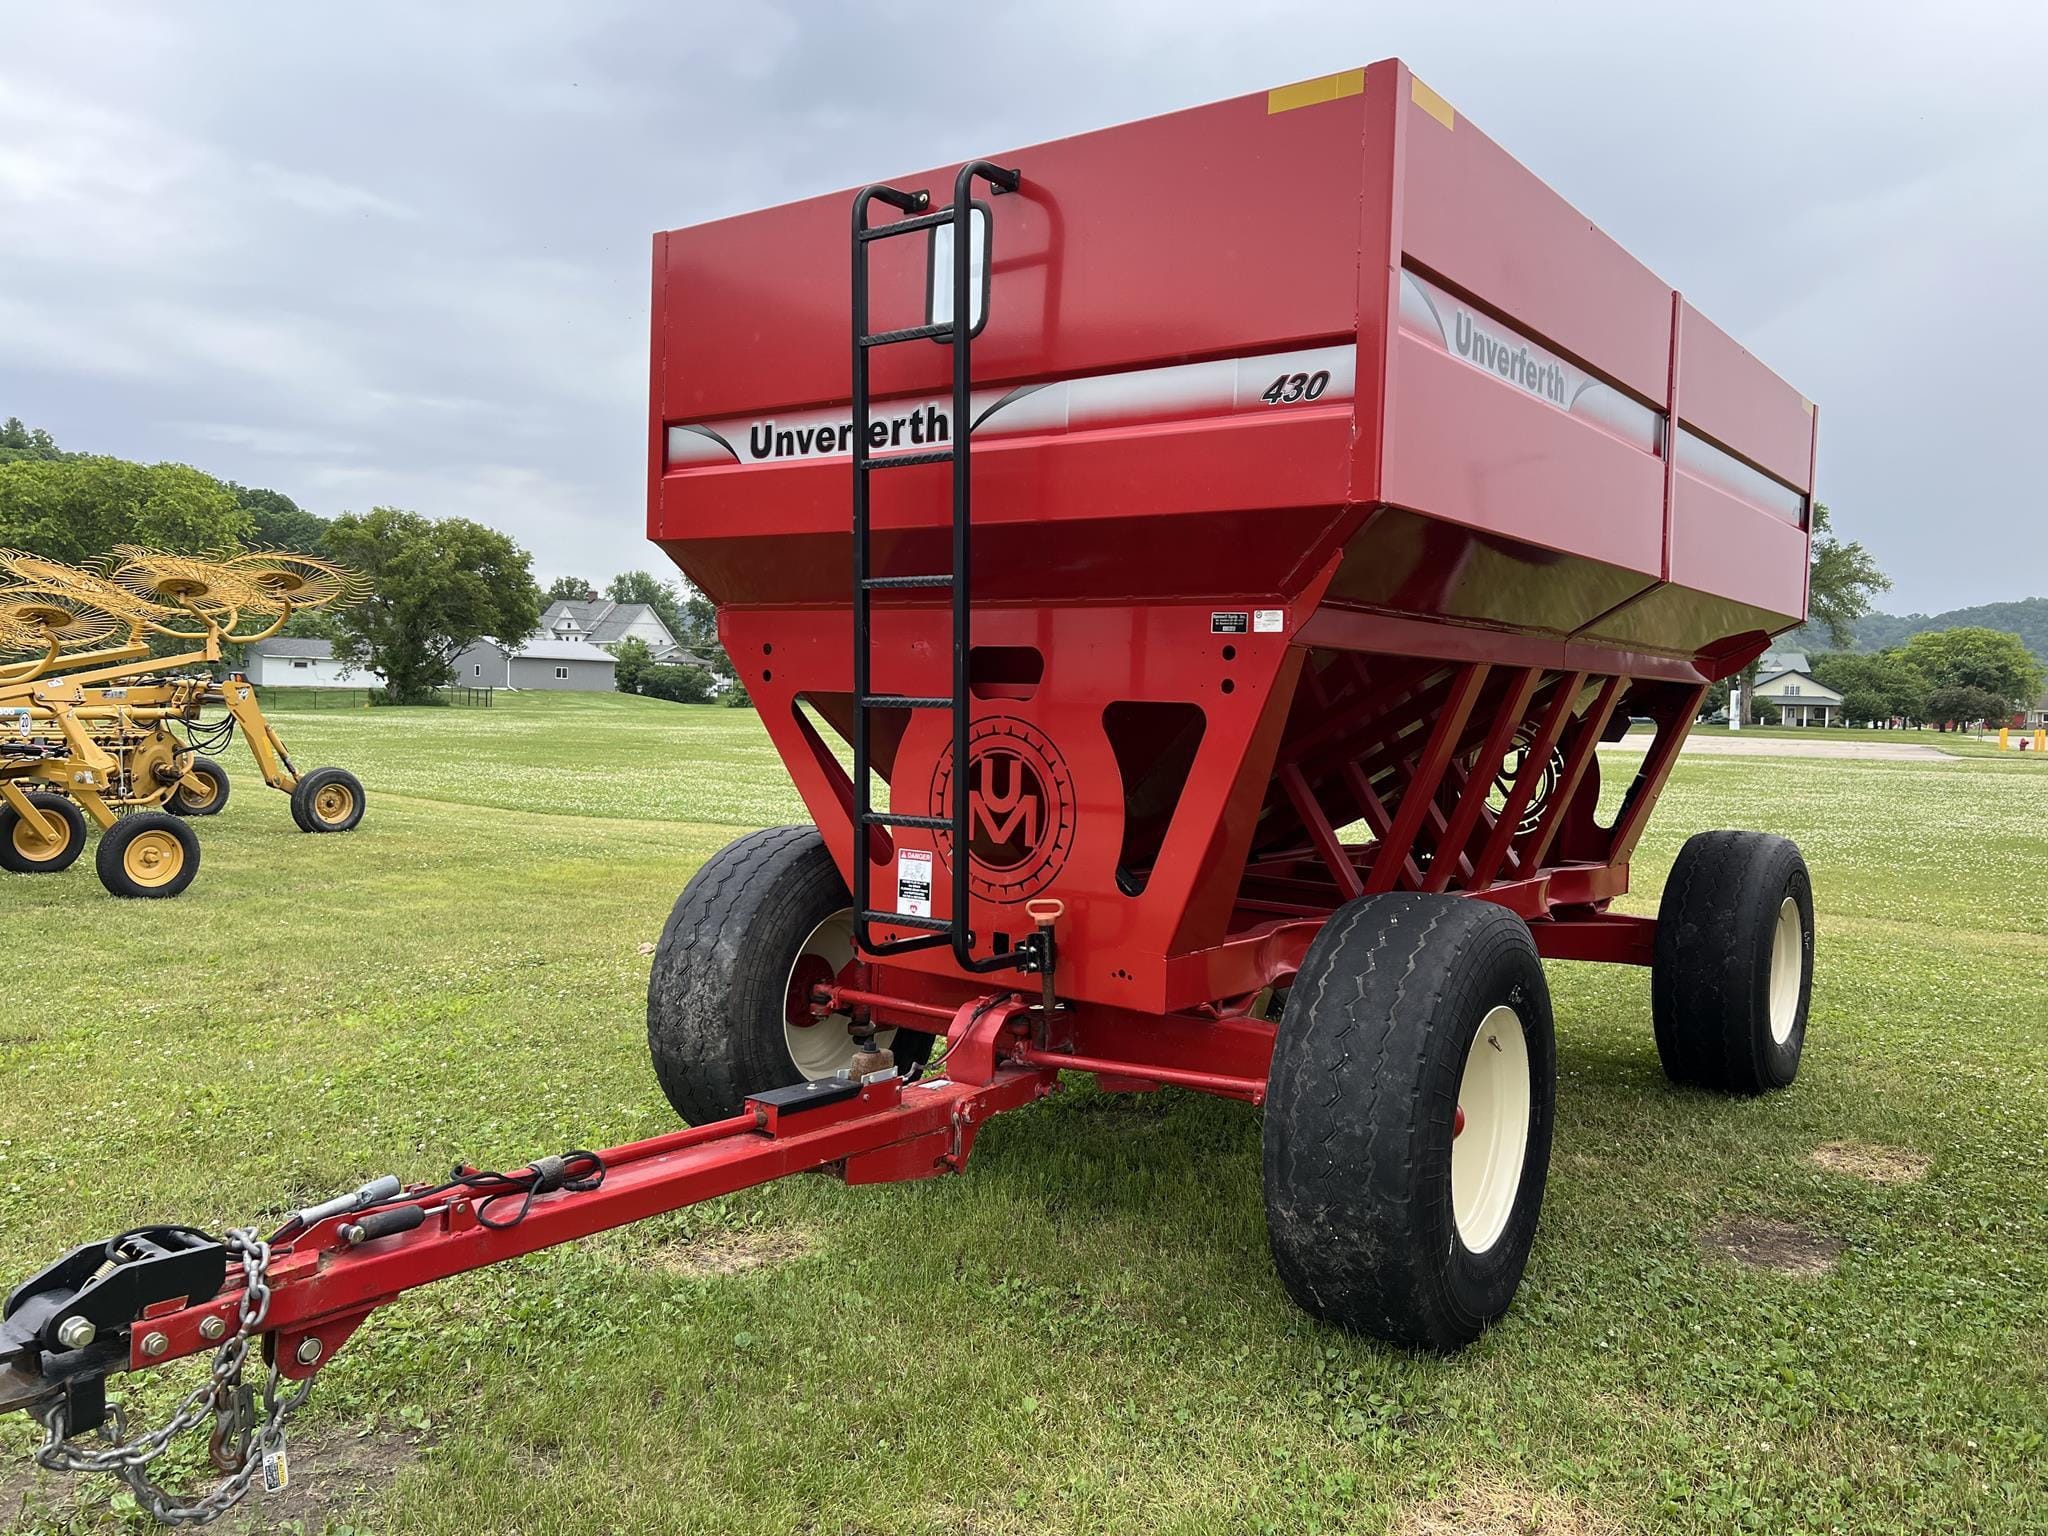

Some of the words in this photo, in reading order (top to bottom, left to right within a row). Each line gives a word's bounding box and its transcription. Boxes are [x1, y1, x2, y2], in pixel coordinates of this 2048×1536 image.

[1455, 310, 1565, 404] Unverferth
[1260, 368, 1332, 405] 430
[750, 405, 949, 460] Unvererth
[907, 851, 931, 861] DANGER
